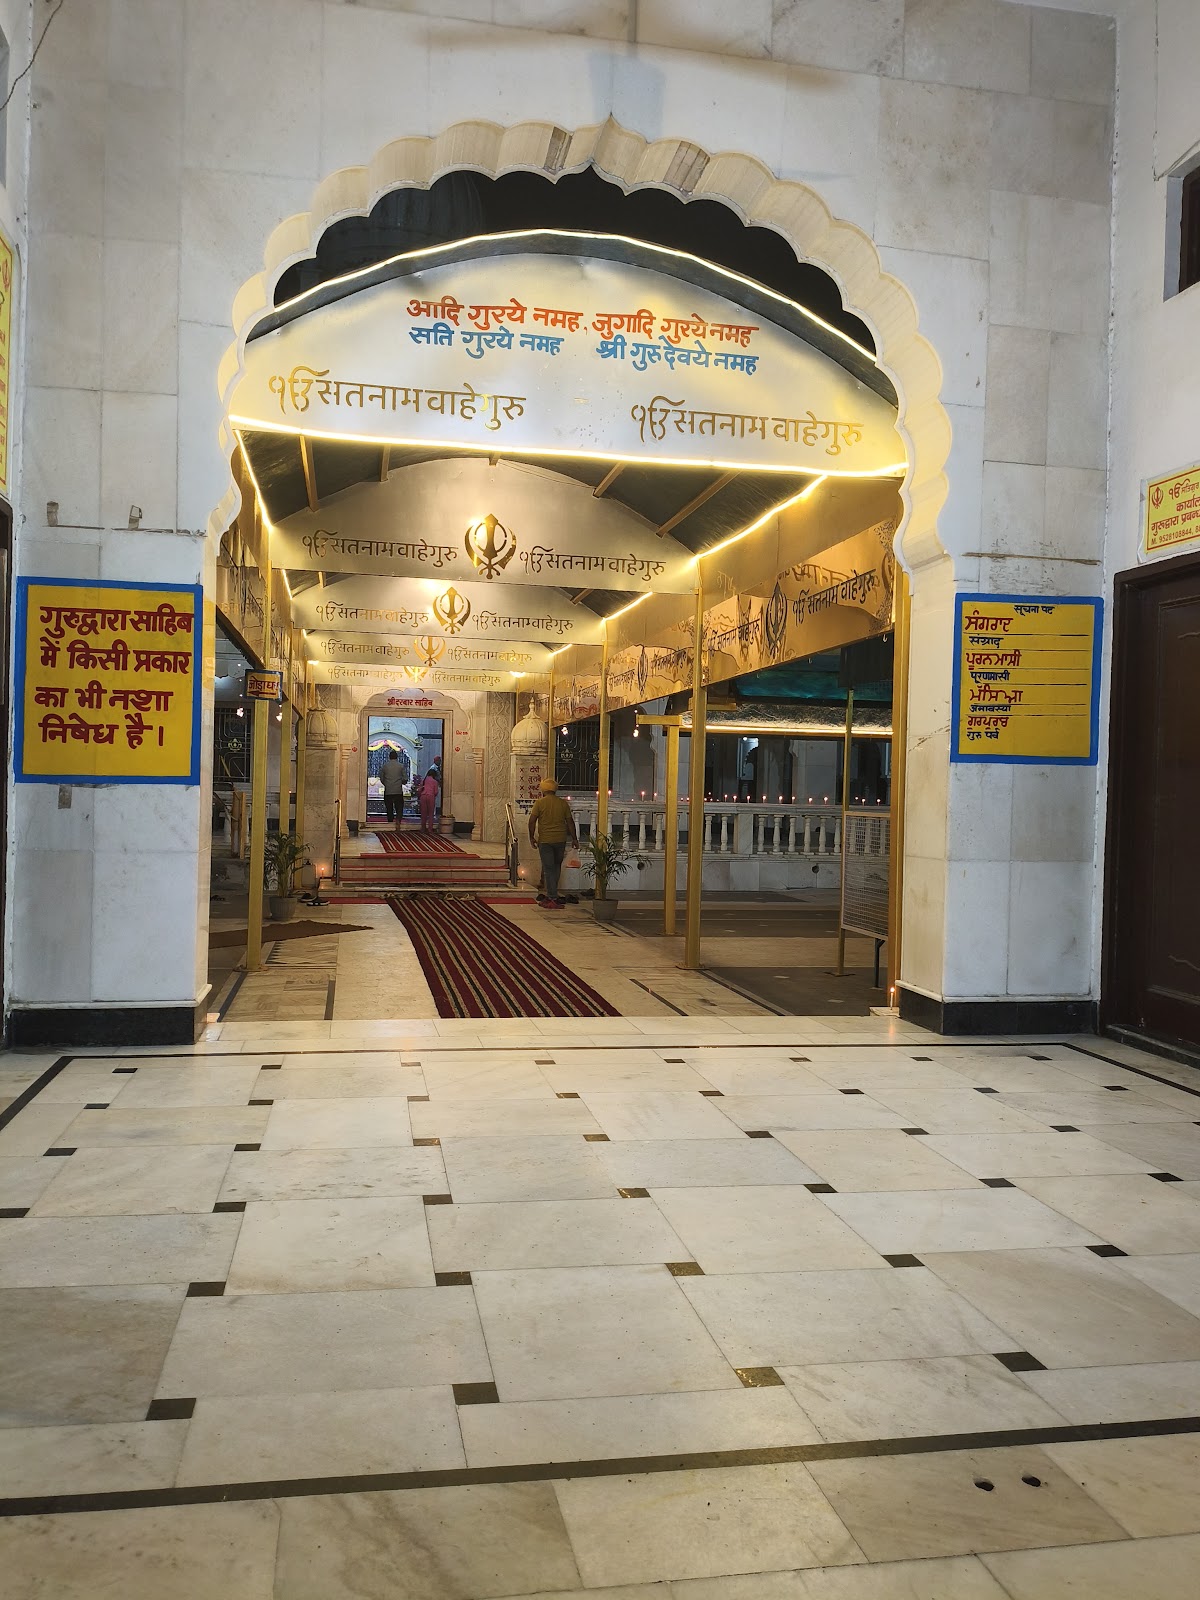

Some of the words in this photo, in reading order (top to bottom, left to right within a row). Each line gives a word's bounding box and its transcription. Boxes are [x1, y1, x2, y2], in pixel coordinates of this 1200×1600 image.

[407, 295, 464, 329] आदि
[467, 298, 527, 330] गुरये
[592, 308, 656, 339] जुगादि
[660, 313, 709, 343] गुरये
[710, 322, 760, 348] नमह
[409, 322, 454, 347] सति
[460, 325, 514, 359] गुरये
[519, 333, 565, 356] नमह
[595, 335, 627, 360] श्री
[713, 352, 759, 376] नमह
[129, 603, 194, 636] साहिब
[1014, 604, 1039, 616] सूचना
[40, 636, 60, 669] में
[67, 640, 130, 671] किसी
[133, 650, 192, 674] प्रकार
[34, 687, 69, 708] का
[75, 680, 107, 709] भी
[109, 689, 174, 712] नशा
[38, 713, 119, 744] निषेध
